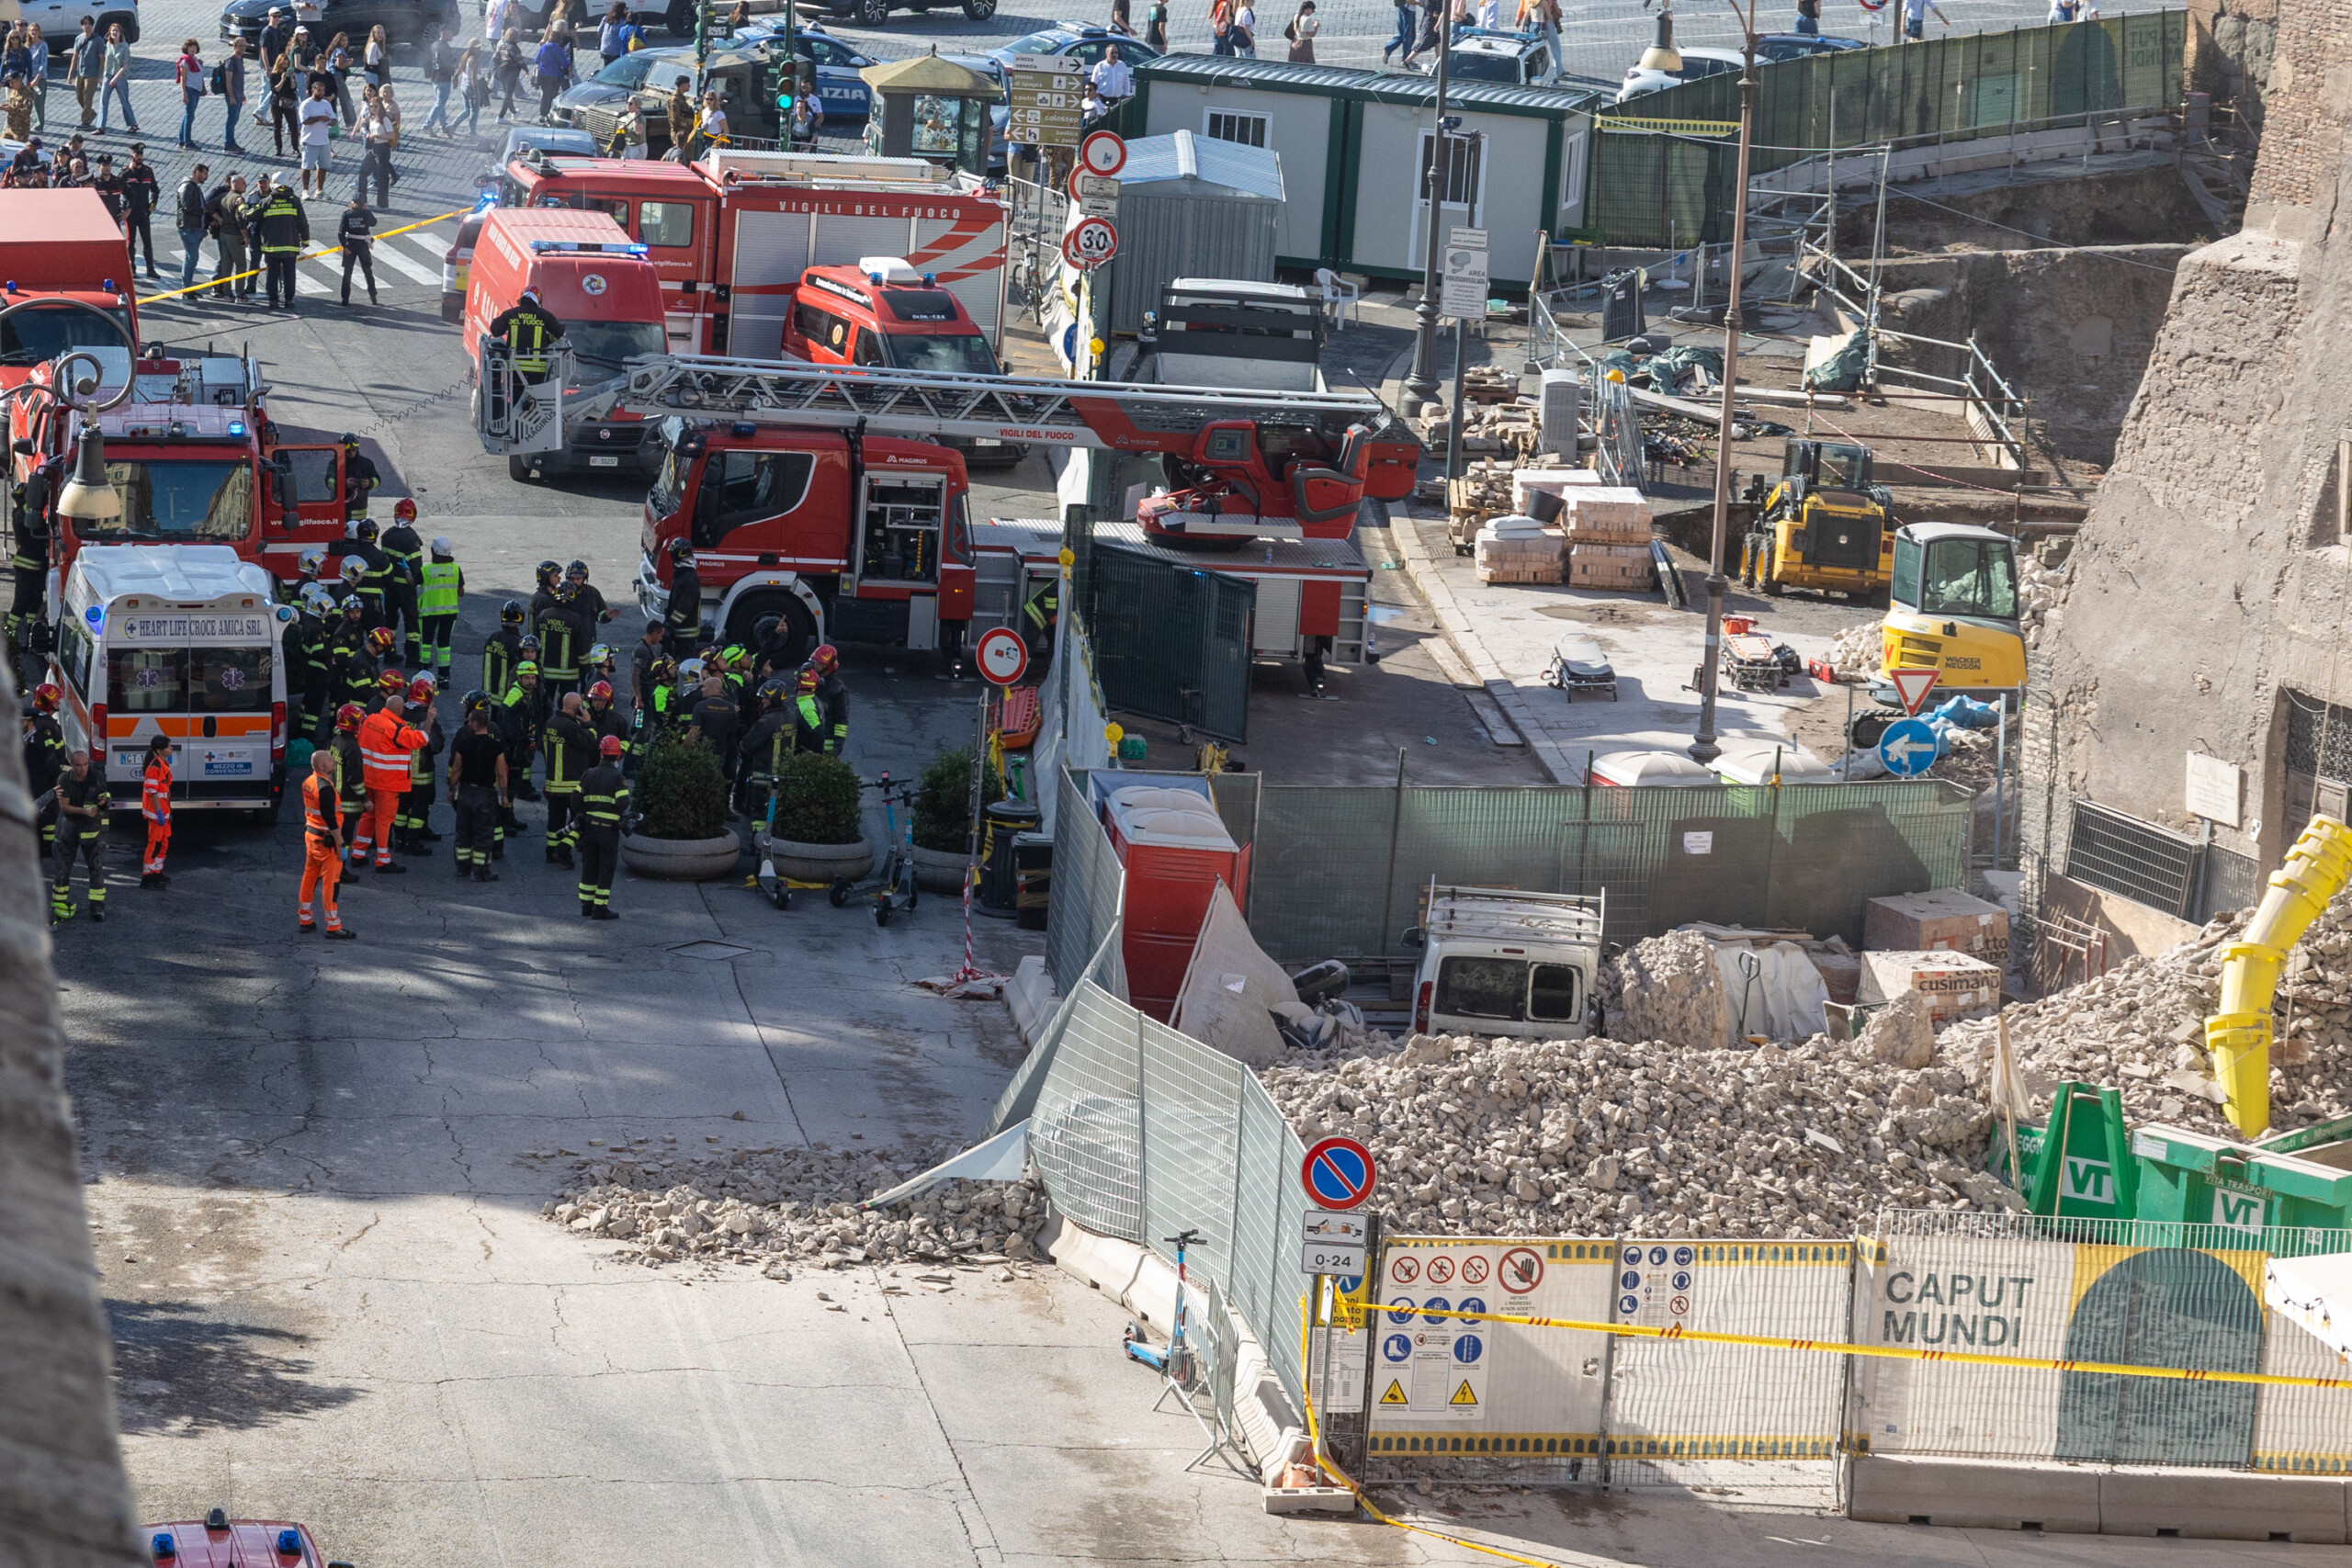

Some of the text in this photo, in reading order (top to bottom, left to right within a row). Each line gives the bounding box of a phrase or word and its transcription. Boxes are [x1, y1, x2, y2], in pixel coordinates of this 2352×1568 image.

[818, 87, 866, 101] IZIA
[1045, 115, 1079, 123] colosseo
[779, 201, 961, 220] VIGILI DEL FUOCO
[1083, 230, 1108, 251] 30
[1468, 269, 1486, 277] AREA
[525, 410, 557, 443] MAGIRUS
[999, 428, 1074, 440] VIGILI DEL FUOCO
[899, 457, 928, 465] MAGIRUS
[270, 518, 339, 527] wwgilfuoco.it
[139, 619, 263, 637] HEART LIFE CROCE AMICA SRL
[546, 617, 565, 626] VIGILI
[1945, 656, 1981, 664] WACKER
[1945, 662, 1981, 671] NEUSON
[1966, 936, 2008, 953] ctto
[1918, 976, 2000, 991] cusimano
[2268, 1136, 2296, 1152] Rifiuti
[2301, 1134, 2308, 1144] e
[2068, 1161, 2111, 1198] VT
[2204, 1174, 2276, 1200] VITA TRASPORTI
[2221, 1192, 2259, 1226] VT
[1315, 1254, 1351, 1268] 0-24
[1886, 1271, 2034, 1308] CAPUT
[1883, 1310, 2021, 1348] MUNDI
